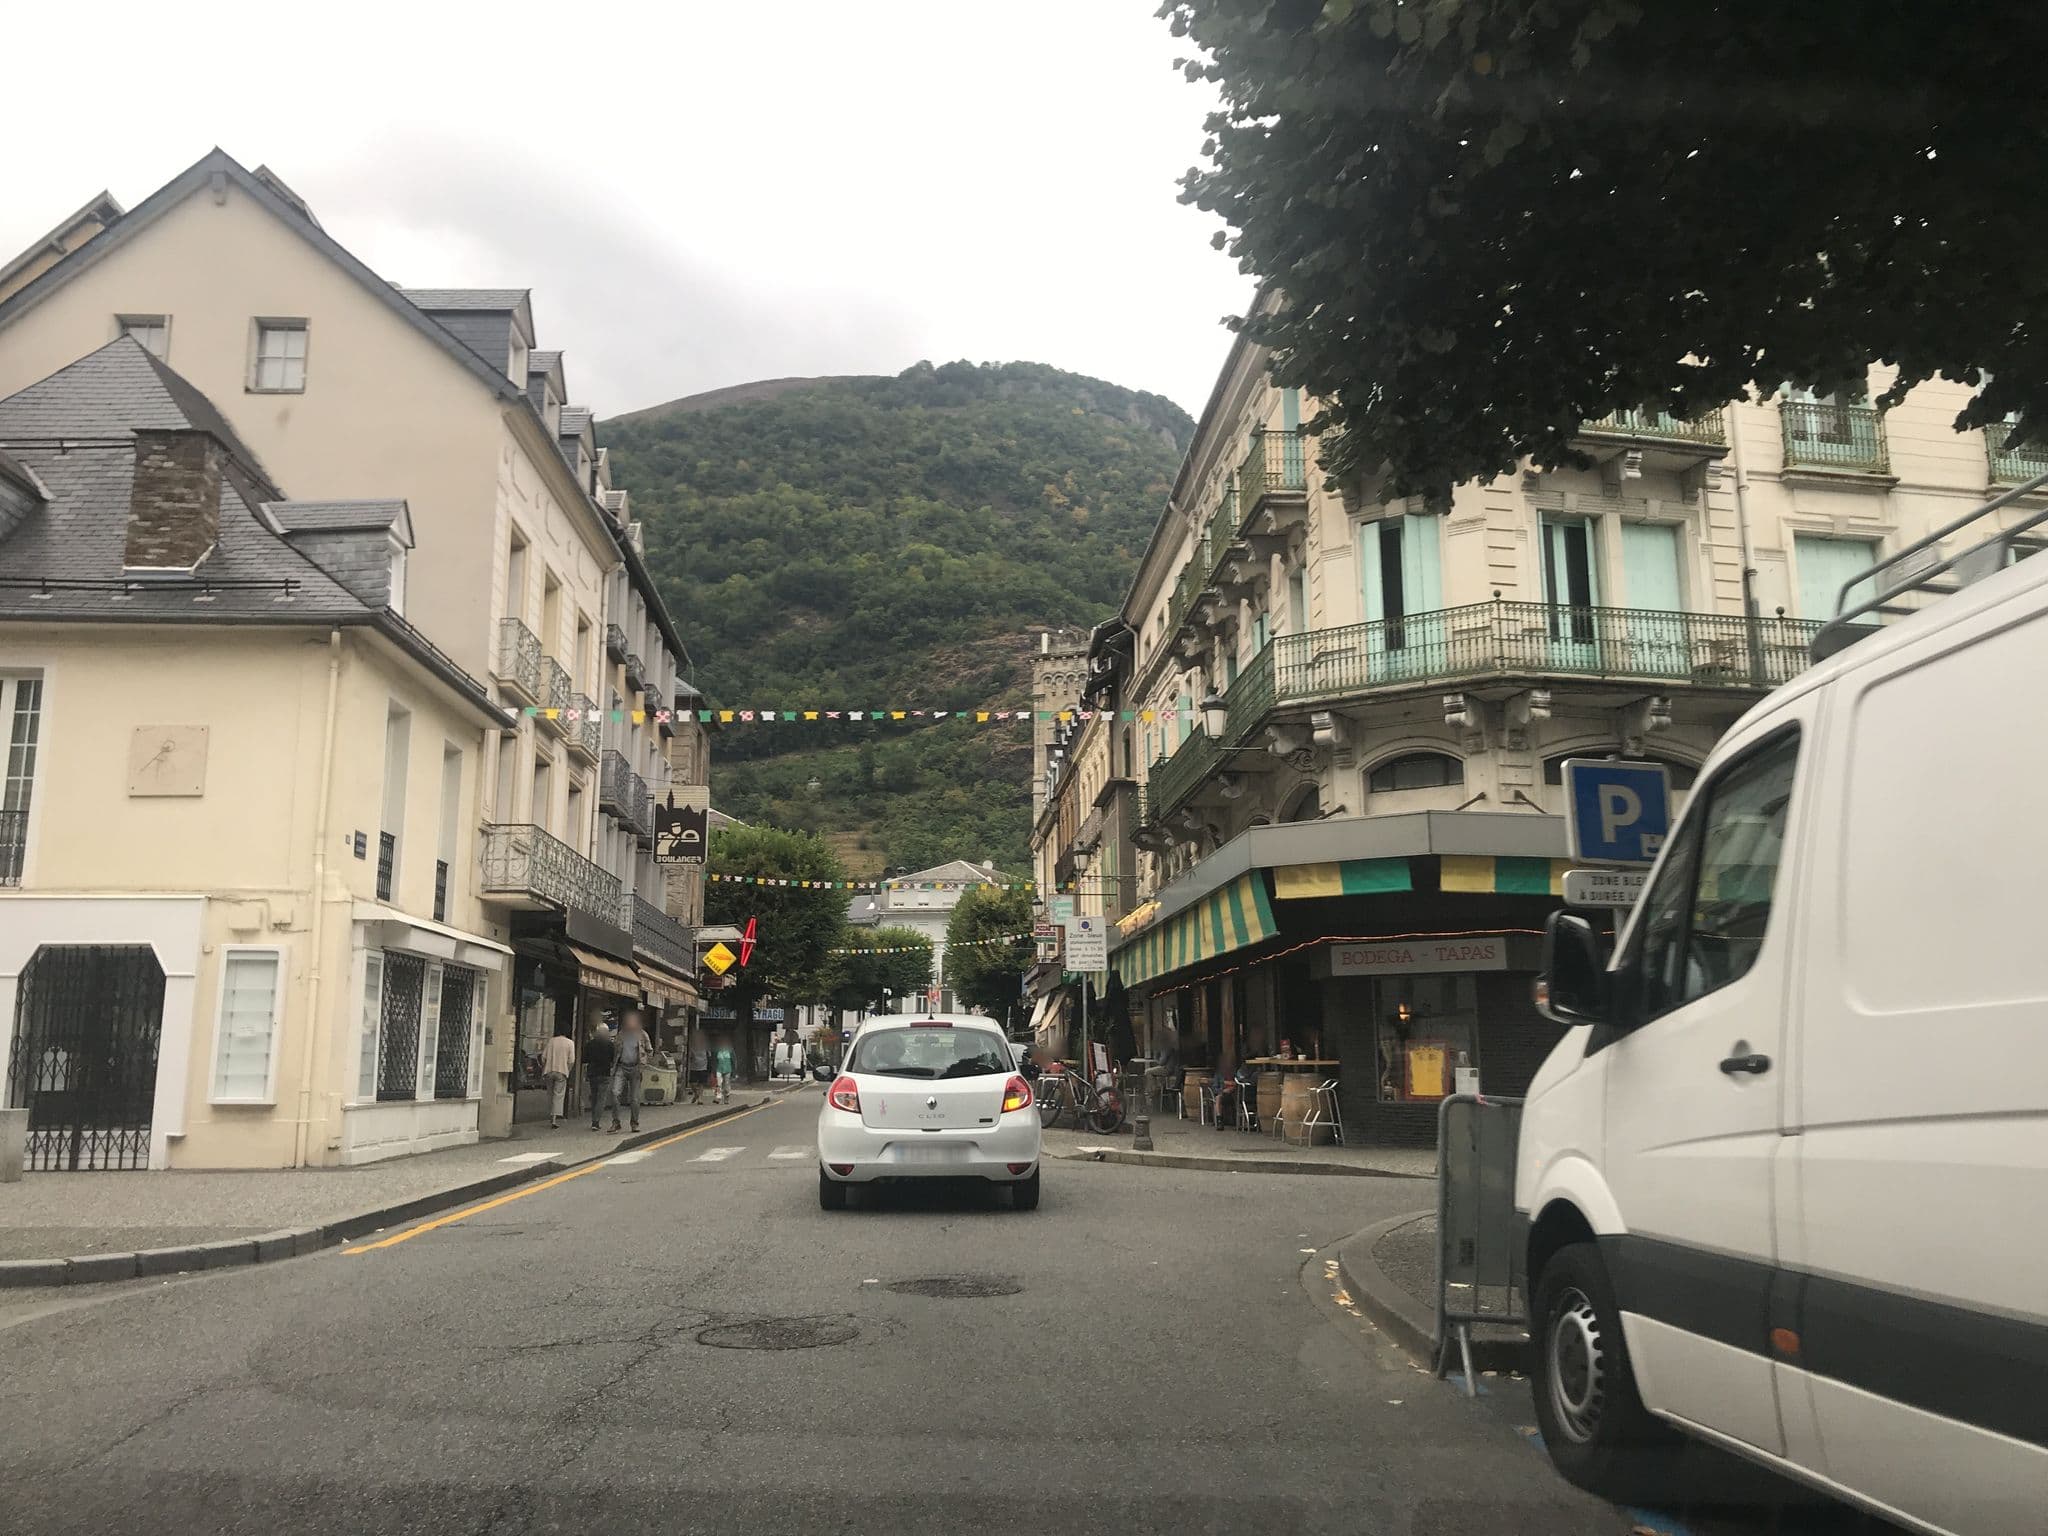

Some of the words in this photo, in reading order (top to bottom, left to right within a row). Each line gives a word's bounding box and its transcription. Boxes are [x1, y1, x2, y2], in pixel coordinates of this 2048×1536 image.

[1598, 784, 1643, 842] P
[1591, 876, 1619, 886] ZONE
[1341, 948, 1415, 966] BODEGA
[1435, 945, 1496, 962] TAPAS
